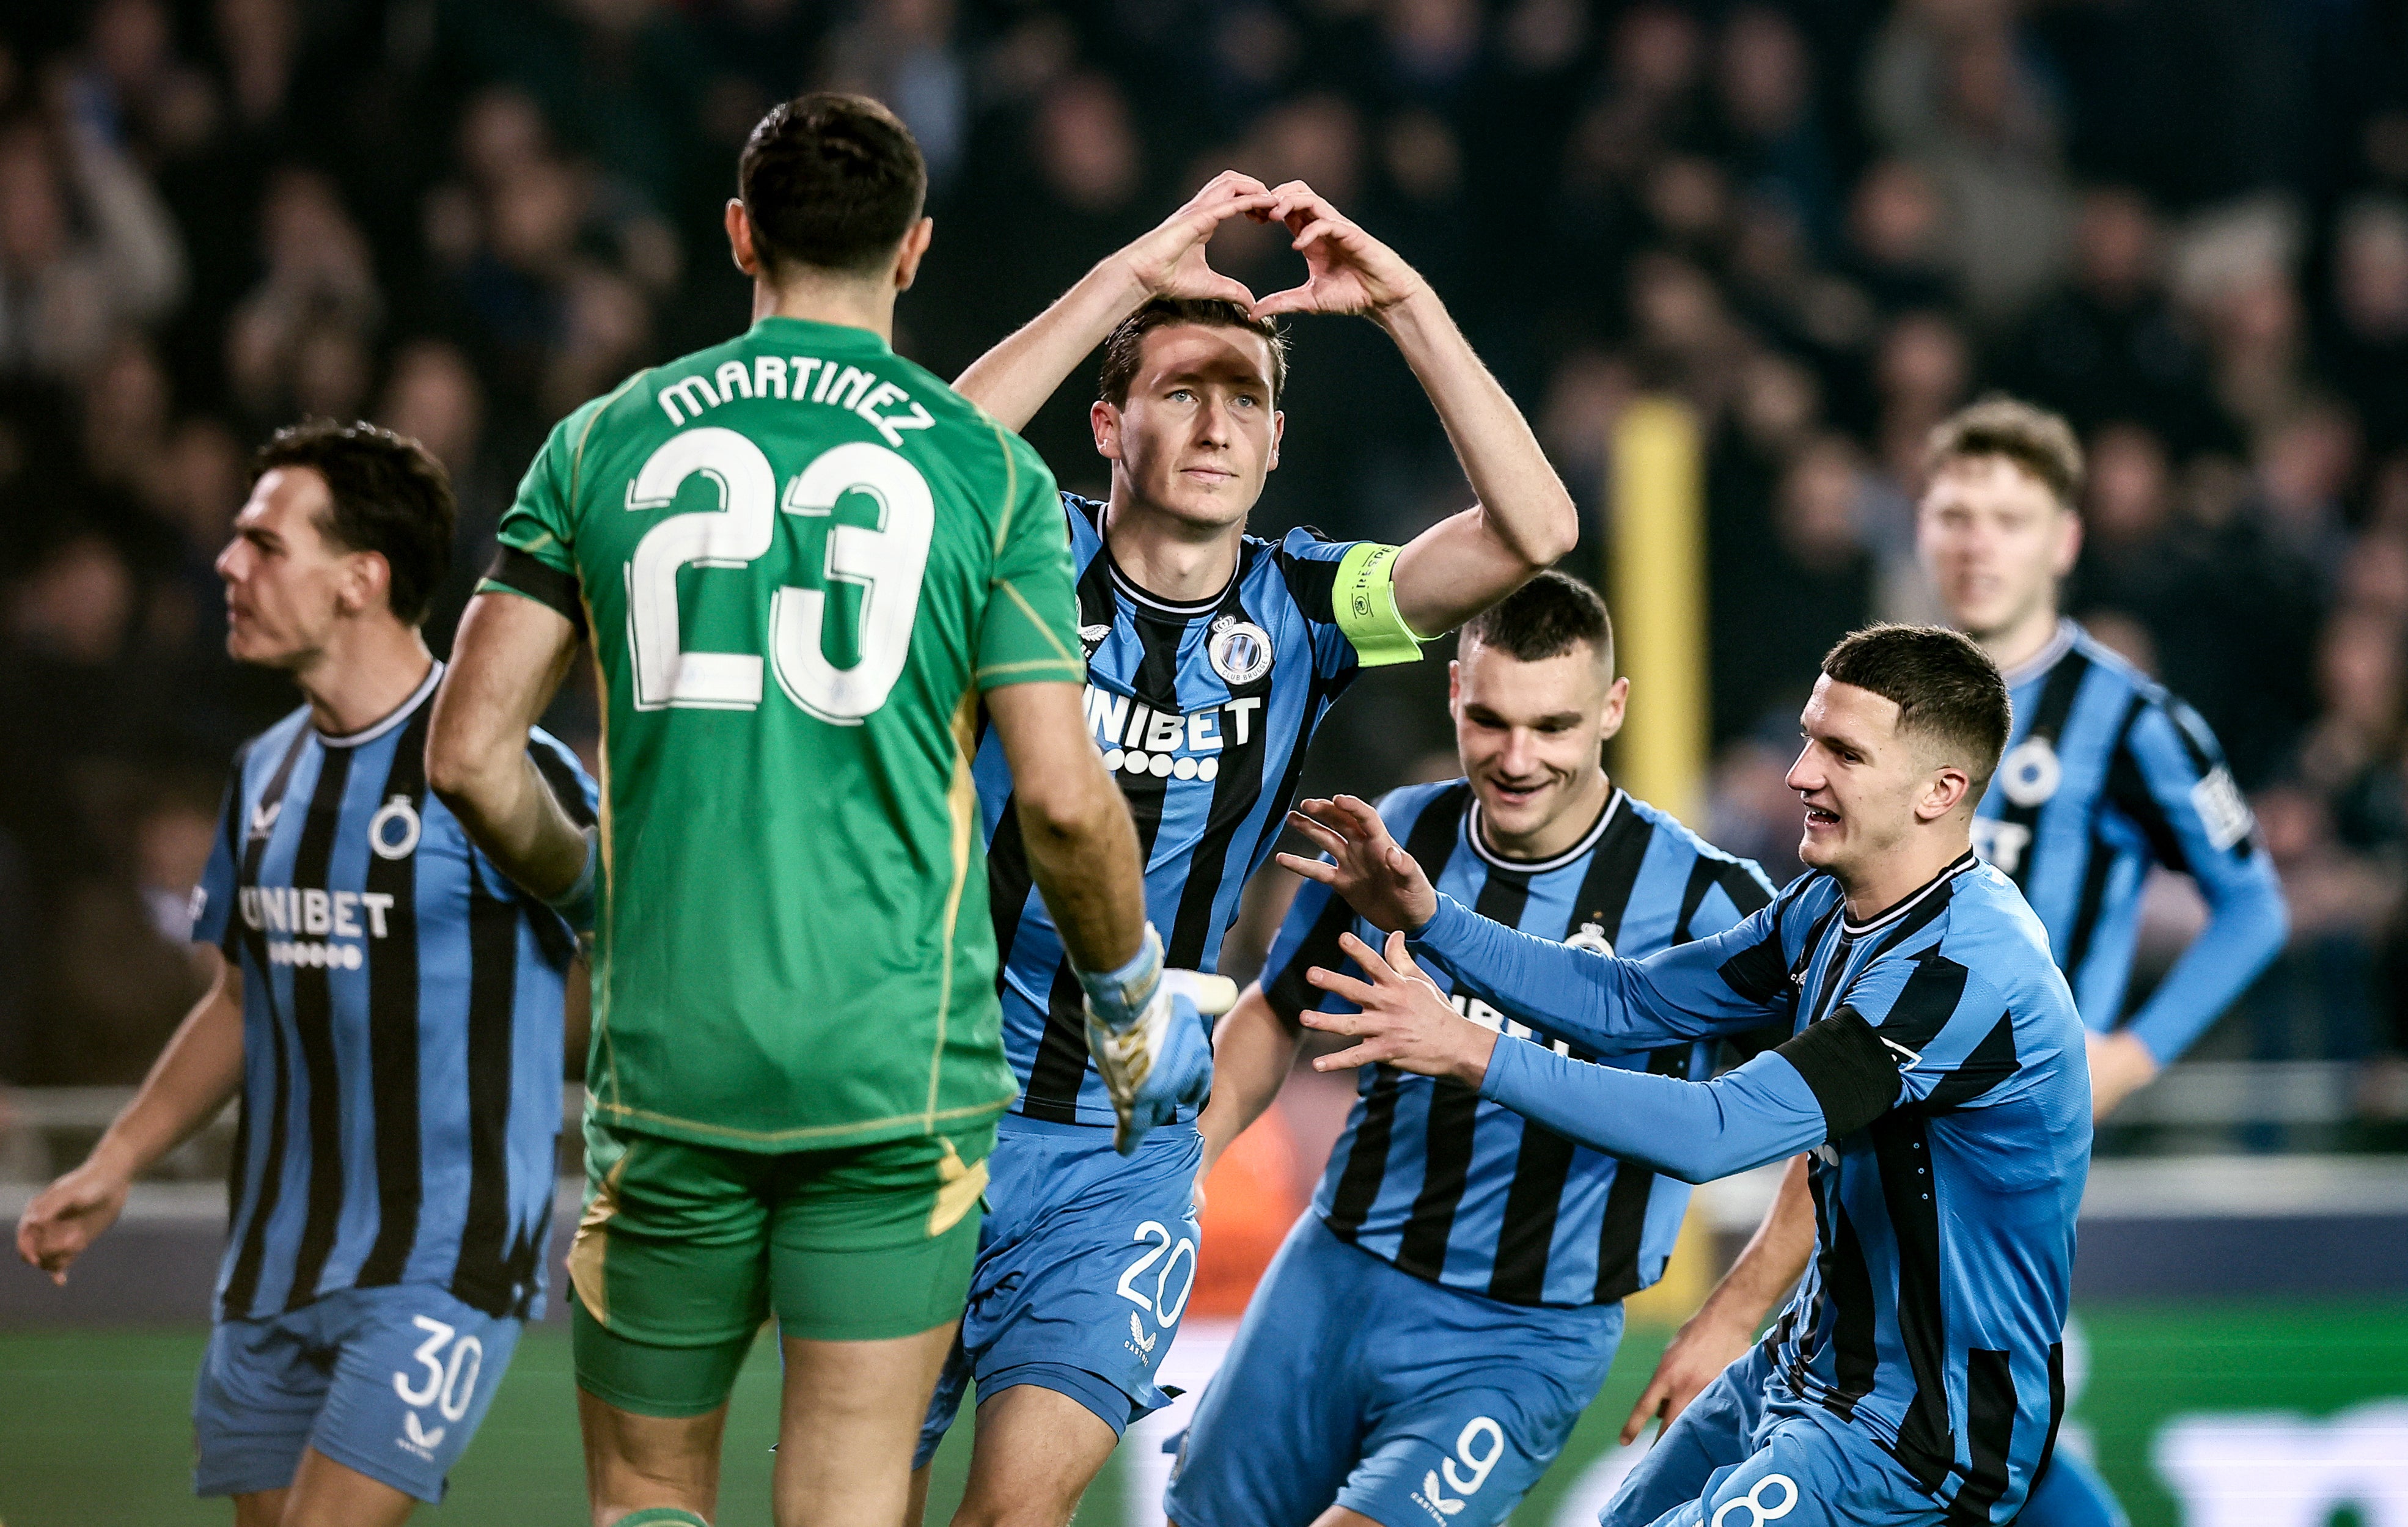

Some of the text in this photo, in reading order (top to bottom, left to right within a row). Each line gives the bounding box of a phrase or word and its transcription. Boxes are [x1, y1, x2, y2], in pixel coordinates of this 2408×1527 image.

[658, 356, 936, 447] MARTINEZ
[623, 427, 935, 726] 23
[1222, 670, 1240, 681] CLUB
[1243, 660, 1268, 680] BRUGGE
[239, 886, 394, 939] UNIBET
[1116, 1220, 1196, 1328] 20
[392, 1314, 483, 1423] 30
[1441, 1416, 1505, 1495] 9
